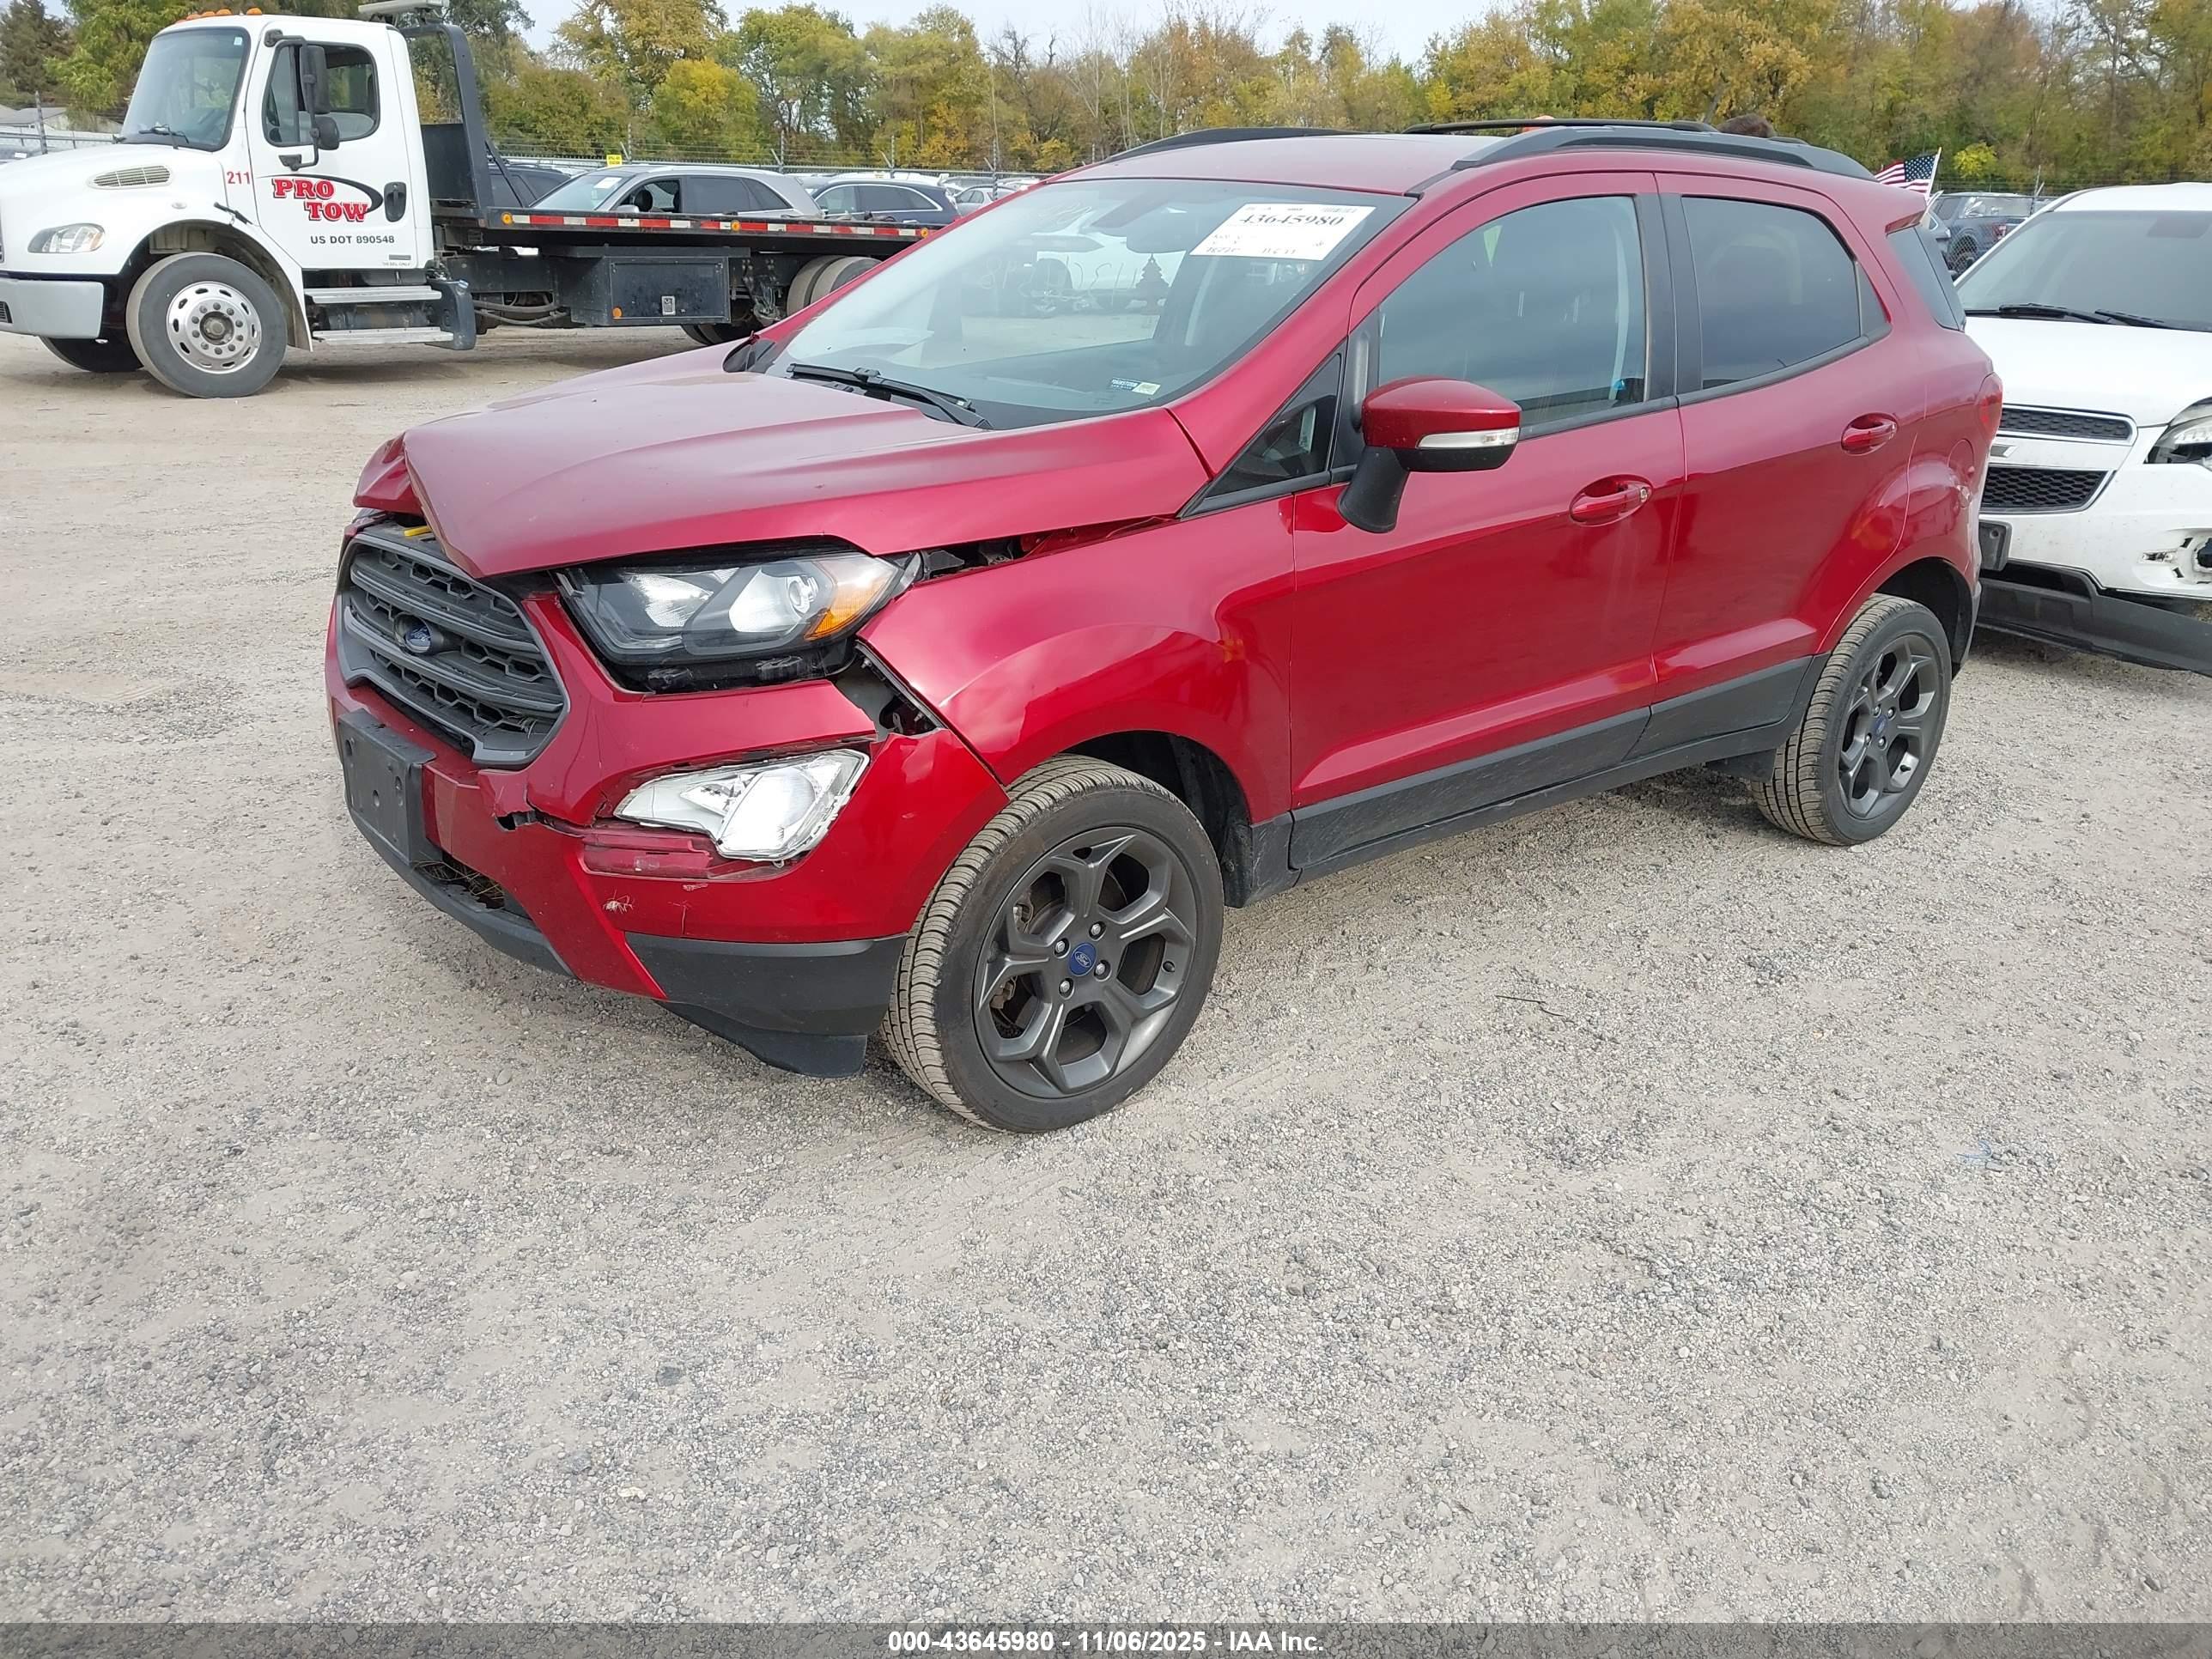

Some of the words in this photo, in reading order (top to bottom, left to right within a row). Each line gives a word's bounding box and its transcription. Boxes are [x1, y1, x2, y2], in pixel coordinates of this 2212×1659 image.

[227, 171, 250, 185] 211
[272, 179, 334, 199] PRO
[304, 202, 368, 222] TOW
[1240, 214, 1344, 226] 43645980
[310, 235, 326, 245] US
[330, 235, 352, 244] DOT
[356, 235, 395, 244] 890548
